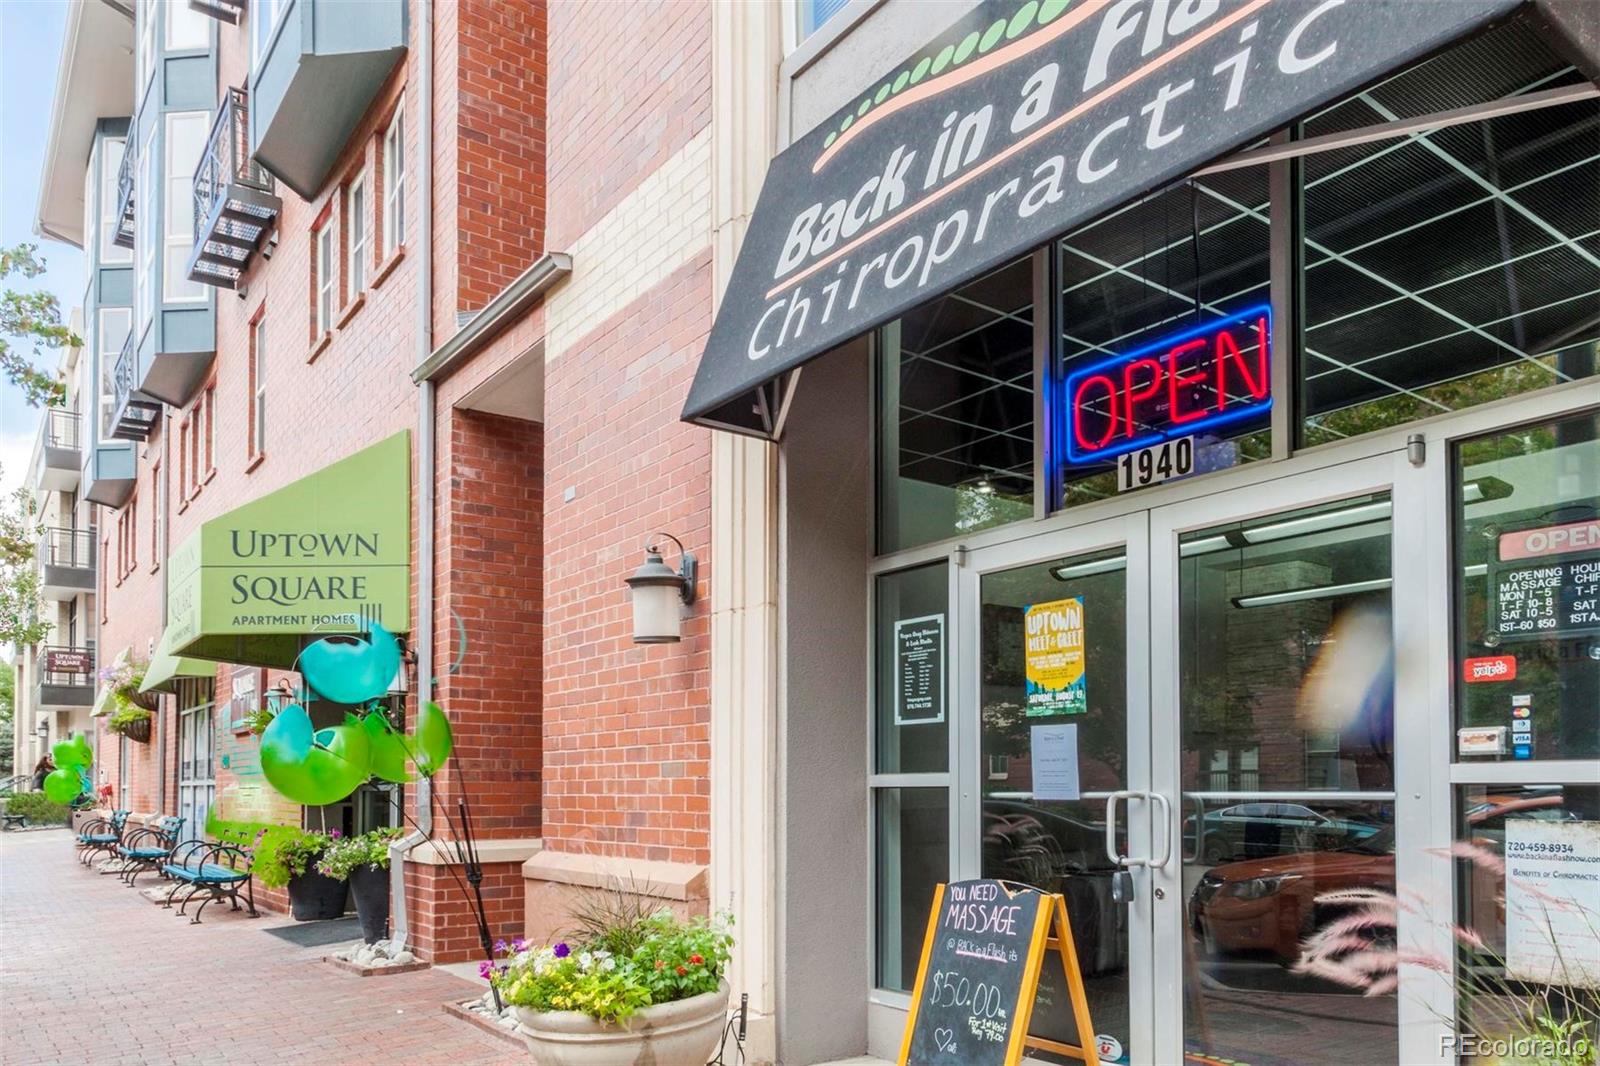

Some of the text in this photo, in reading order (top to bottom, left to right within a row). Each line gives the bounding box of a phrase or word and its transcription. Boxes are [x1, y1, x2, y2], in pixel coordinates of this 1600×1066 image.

[774, 144, 917, 279] Back
[923, 104, 993, 190] in
[1010, 62, 1060, 134] a
[748, 0, 1346, 361] Chiropractic
[1074, 316, 1268, 451] OPEN
[1122, 438, 1193, 489] 1940
[230, 530, 378, 558] UPTOWN
[1509, 562, 1600, 582] OPENING HOU
[231, 574, 367, 606] SQUARE
[1500, 577, 1562, 593] MASSAGE
[1576, 584, 1598, 596] T-F
[1500, 591, 1525, 602] MON
[1500, 600, 1524, 611] T-F
[1573, 599, 1597, 611] SAT
[232, 615, 356, 625] APARTMENT HOMES
[1028, 606, 1081, 635] UPTOWN
[1501, 609, 1523, 620] SAT
[1537, 618, 1557, 629] $50
[1473, 665, 1497, 678] yelp
[1507, 842, 1574, 853] 720-459-8934
[969, 885, 998, 902] NEED
[945, 904, 1021, 936] MASSAGE
[929, 969, 1000, 1018] $50.00
[968, 1016, 981, 1028] For
